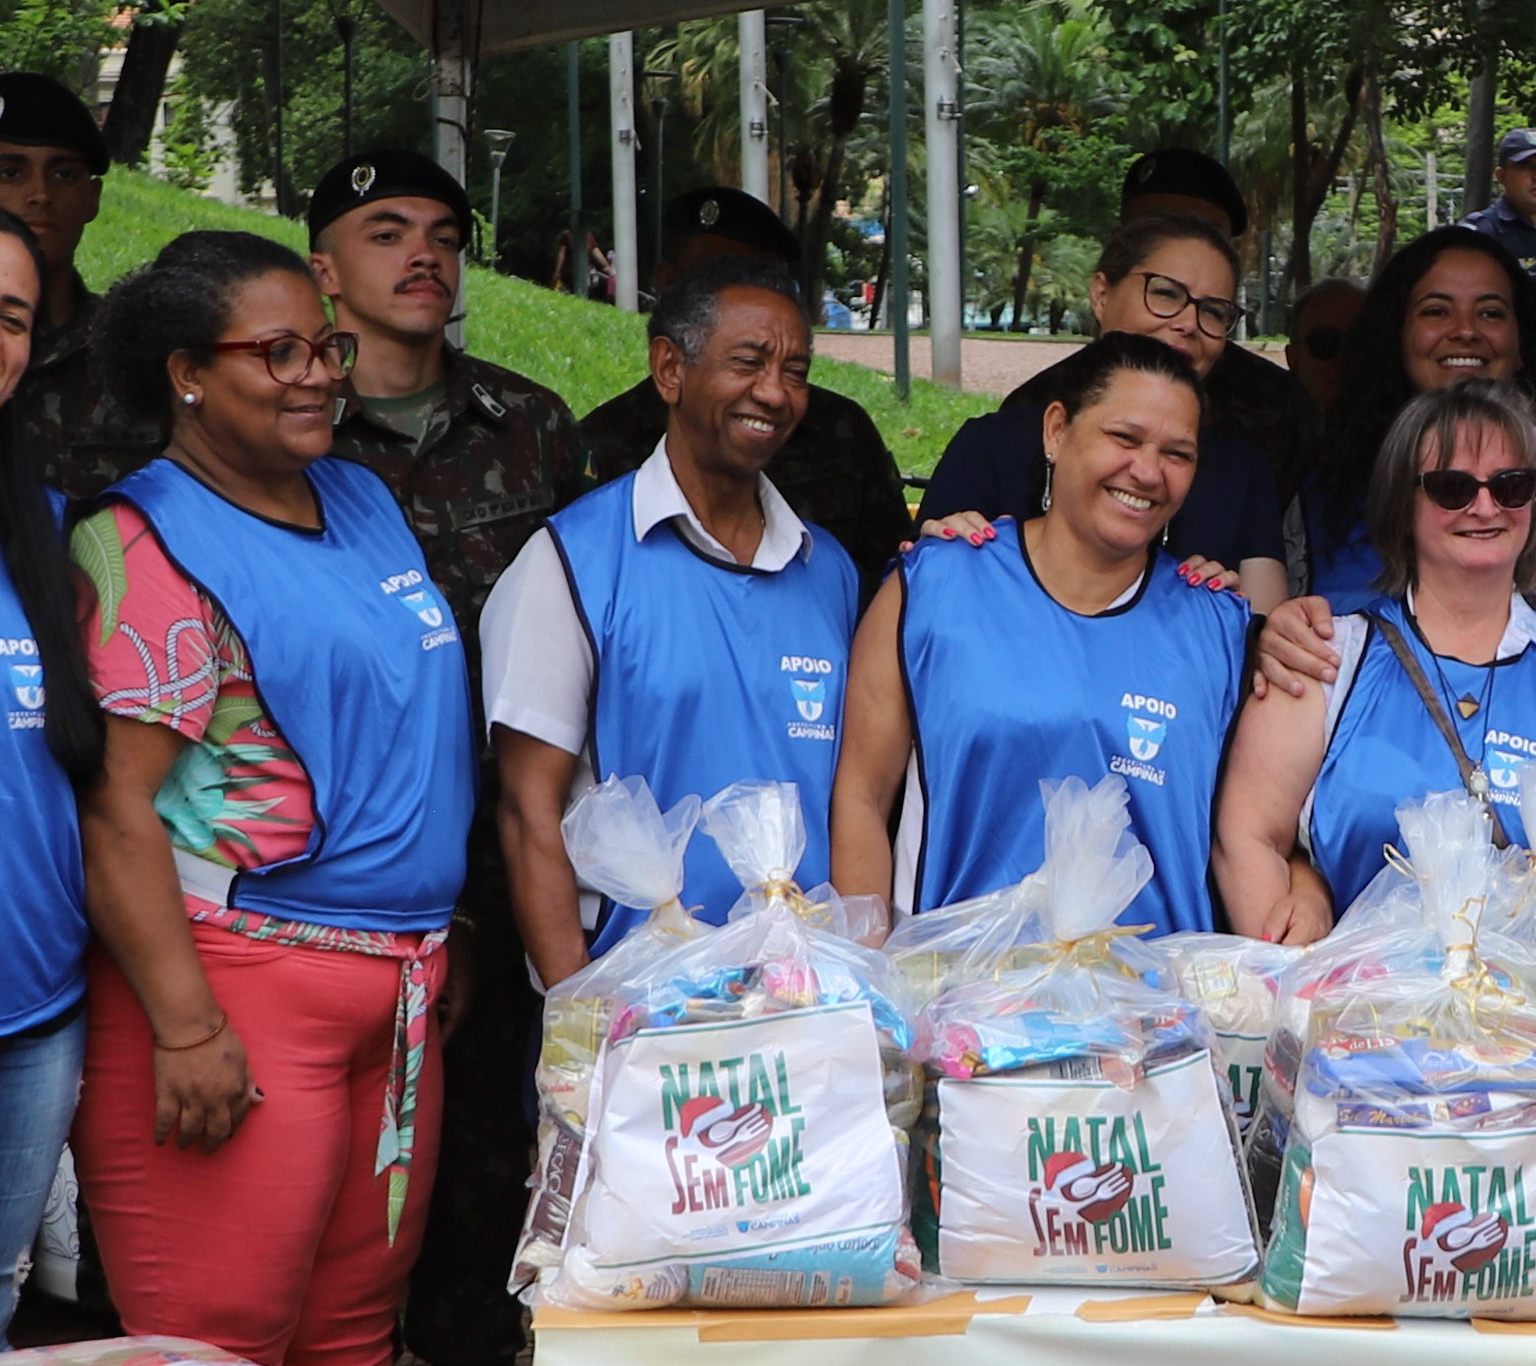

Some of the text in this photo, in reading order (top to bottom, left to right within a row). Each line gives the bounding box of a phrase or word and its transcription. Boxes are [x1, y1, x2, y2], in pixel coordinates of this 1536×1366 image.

[380, 569, 423, 594] APOIO
[781, 656, 832, 673] APOIO
[1121, 693, 1177, 719] APOIO
[1110, 761, 1165, 786] CAMPINAS
[659, 1050, 802, 1131] NATAL
[665, 1117, 812, 1215] SEM FOME
[1028, 1110, 1162, 1182] NATAL
[1028, 1175, 1173, 1256] SEM FOME
[1406, 1163, 1536, 1231] NATAL
[1399, 1237, 1457, 1303] SEM
